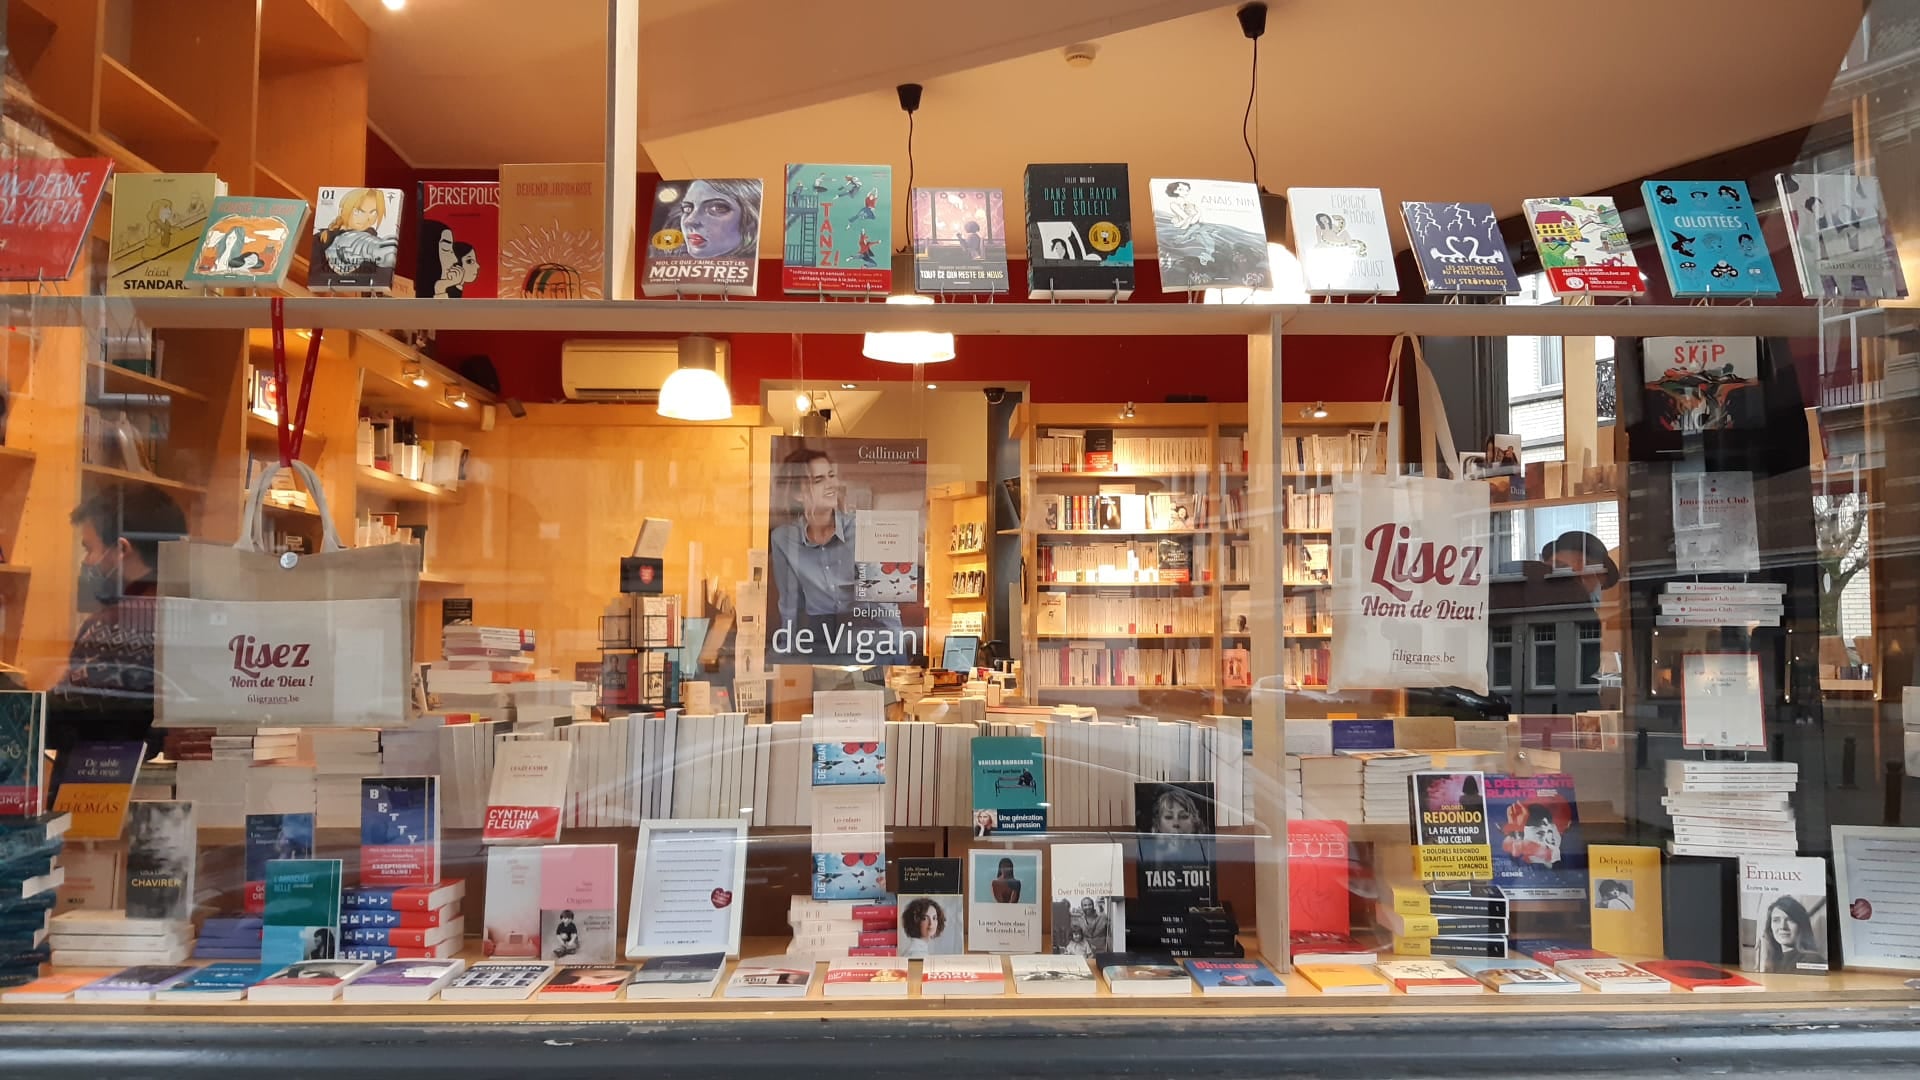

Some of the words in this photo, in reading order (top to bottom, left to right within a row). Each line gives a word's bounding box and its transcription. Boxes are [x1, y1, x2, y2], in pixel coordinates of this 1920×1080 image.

[321, 189, 335, 201] 01
[428, 184, 500, 209] PERSEPOLIS
[1044, 186, 1066, 201] DANS
[1072, 186, 1083, 201] UN
[1089, 186, 1118, 201] RAYON
[1053, 200, 1066, 216] DE
[1073, 200, 1111, 216] SOLEIL
[1673, 213, 1743, 229] CULOTTÉES
[649, 265, 750, 280] MONSTRES
[858, 445, 920, 461] Gallimard
[1364, 522, 1483, 602] Lisez
[853, 607, 901, 618] Delphine
[1361, 596, 1407, 618] Nom
[1410, 599, 1433, 619] de
[1436, 599, 1475, 620] Dieu
[772, 620, 814, 654] de
[822, 621, 917, 664] Vigan
[228, 634, 311, 679] Lisez
[1391, 649, 1456, 665] filigranes.be
[229, 676, 258, 688] Nom
[260, 676, 275, 688] de
[277, 676, 305, 688] Dieu
[84, 758, 97, 768] De
[88, 768, 98, 776] de
[59, 801, 119, 814] THOMAS
[489, 809, 540, 820] CYNTHIA
[1011, 814, 1044, 823] génération
[1423, 811, 1482, 824] REDONDO
[487, 819, 533, 830] FLEURY
[1016, 822, 1041, 830] pression
[1428, 826, 1438, 835] LA
[1439, 826, 1457, 835] FACE
[1458, 826, 1480, 835] NORD
[1437, 836, 1449, 844] DU
[1450, 836, 1473, 844] CŒUR
[1288, 842, 1346, 858] LUB
[1599, 856, 1633, 866] Deborah
[1746, 865, 1802, 881] Ernaux
[131, 878, 182, 889] CHAVIRER
[1057, 888, 1072, 896] Over
[1074, 887, 1084, 896] the
[1086, 887, 1113, 896] Rainbow
[344, 930, 385, 941] ETTY
